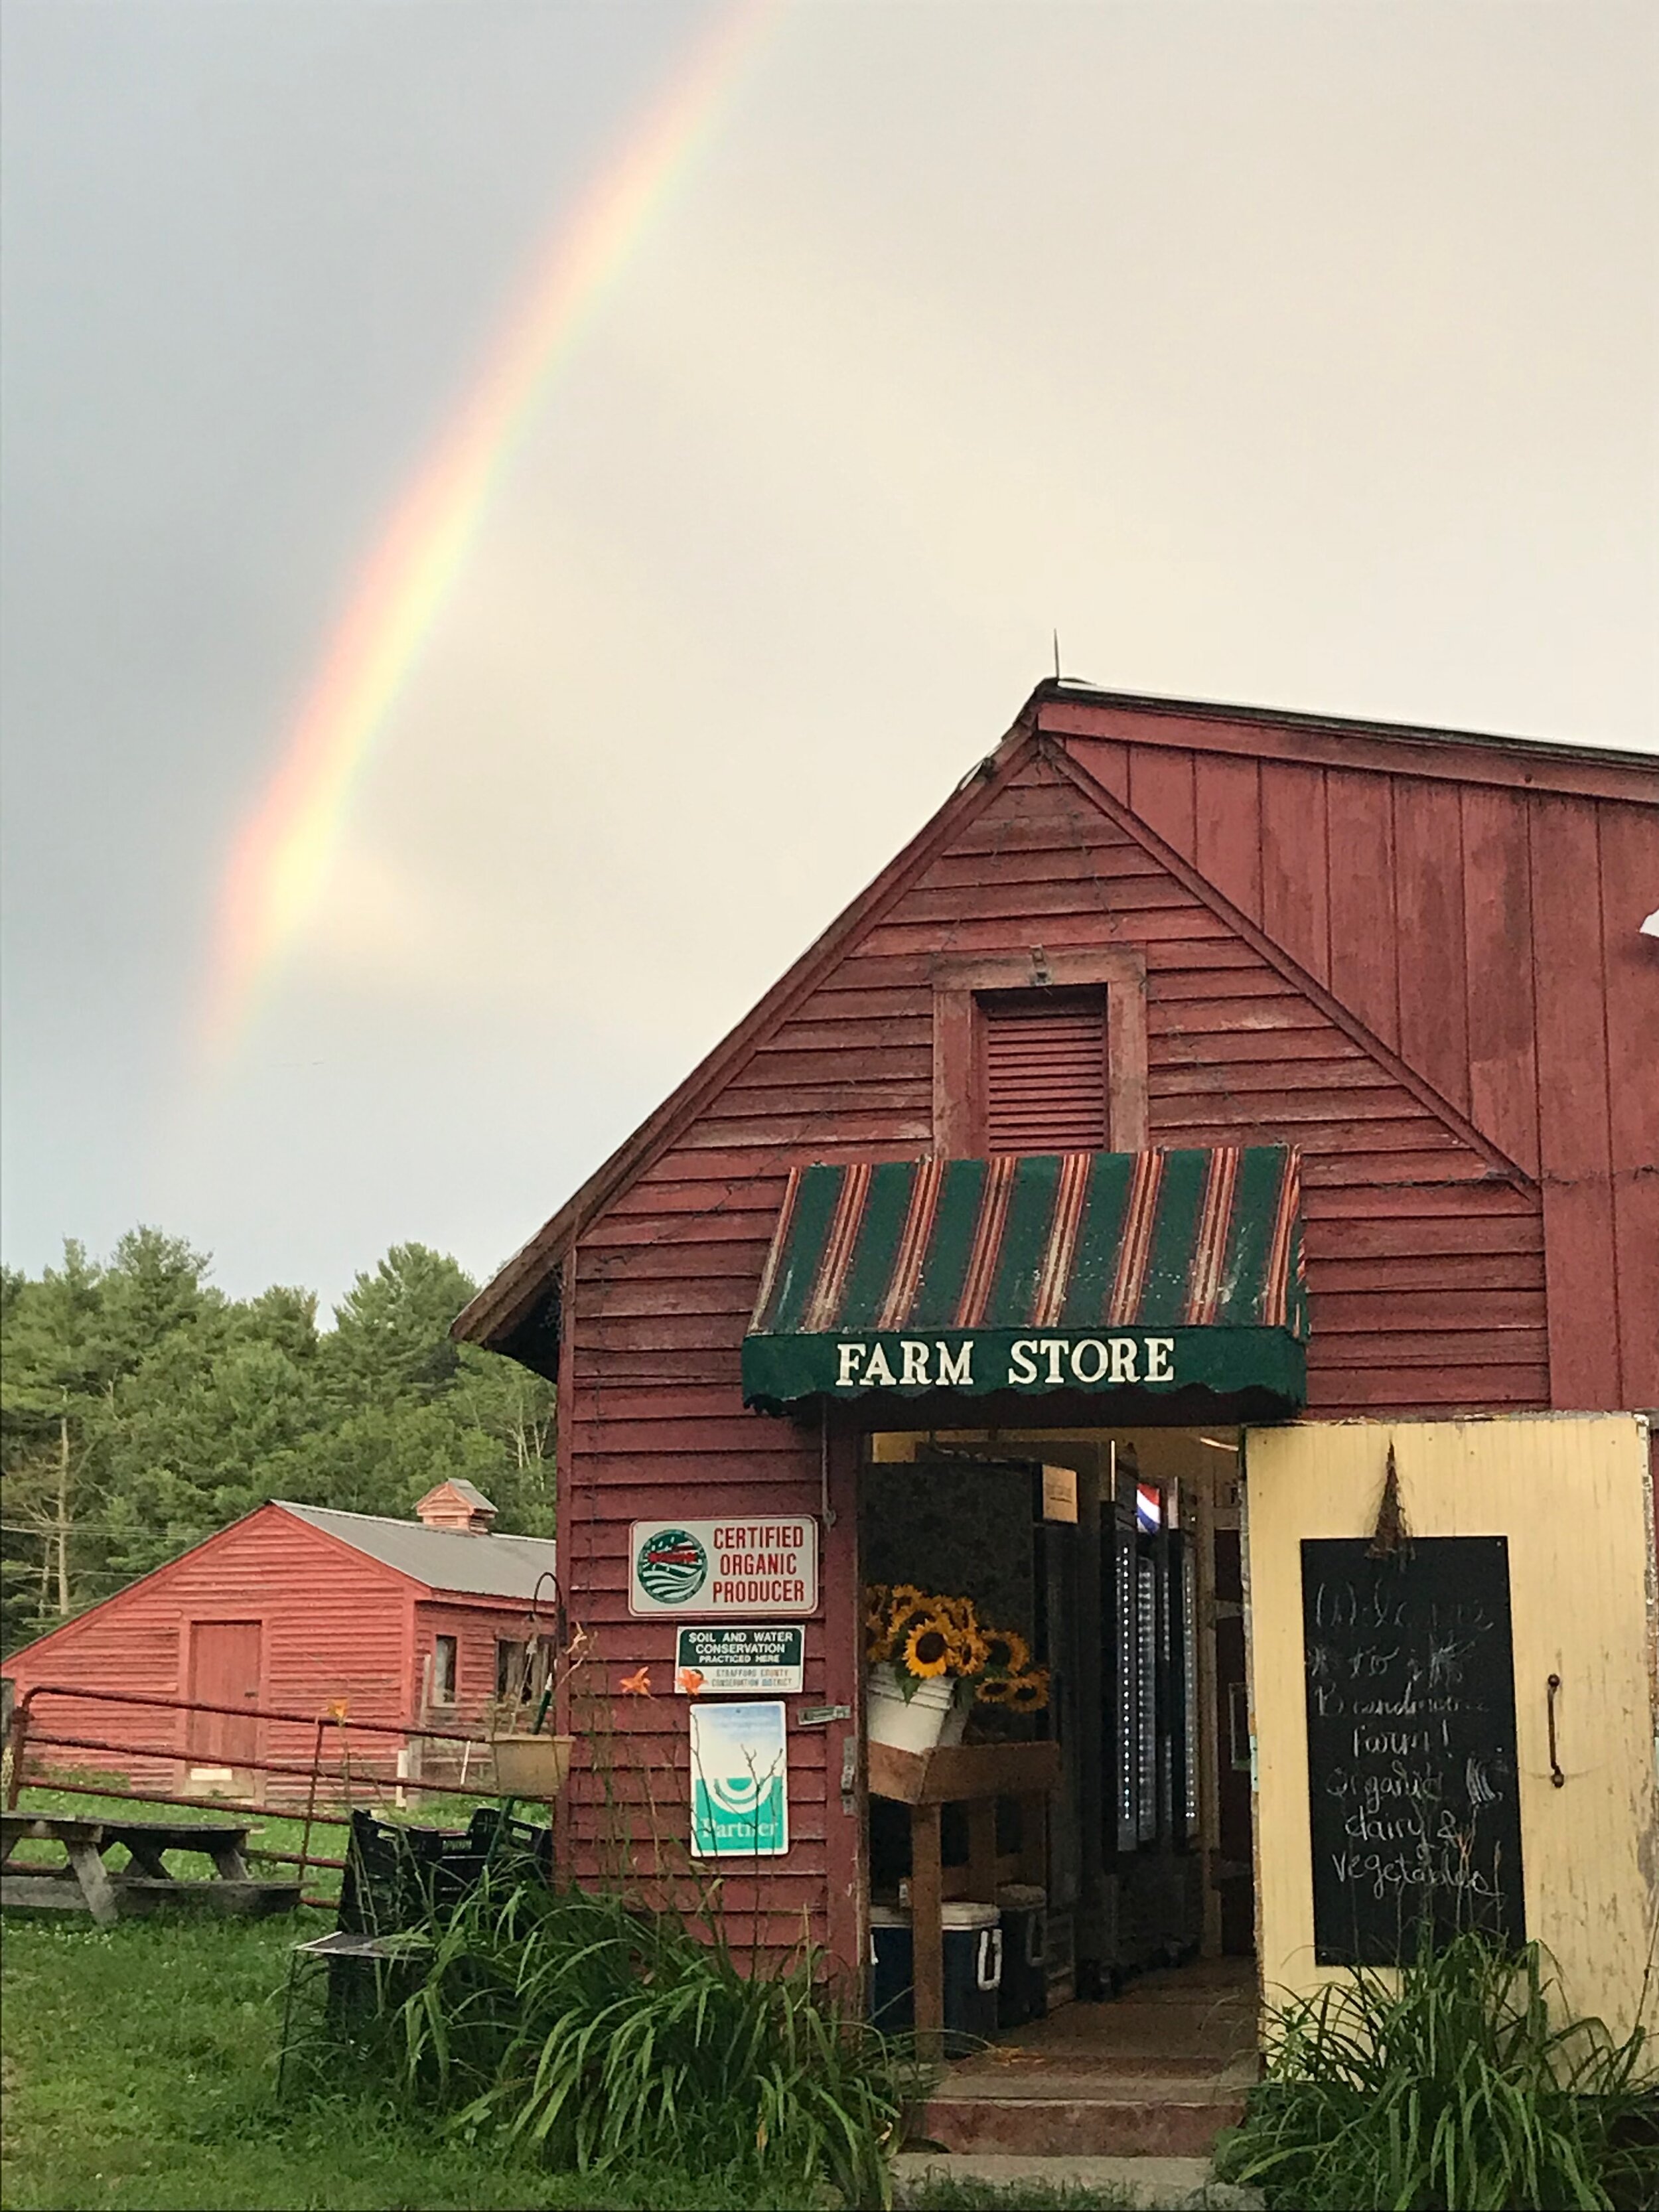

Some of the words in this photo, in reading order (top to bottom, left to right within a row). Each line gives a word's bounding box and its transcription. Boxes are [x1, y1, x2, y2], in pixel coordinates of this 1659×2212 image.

[836, 1339, 974, 1386] FARM
[1008, 1337, 1175, 1384] STORE
[713, 1526, 804, 1550] CERTIFIED
[719, 1552, 797, 1576] ORGANIC
[713, 1580, 805, 1603] PRODUCER
[688, 1632, 716, 1643] SOIL
[722, 1632, 747, 1643] AND
[754, 1631, 793, 1642] WATER
[695, 1643, 786, 1654] CONSERVATION
[699, 1655, 751, 1664] PRACTICED
[755, 1655, 780, 1663] HERE
[701, 1817, 778, 1838] Partner
